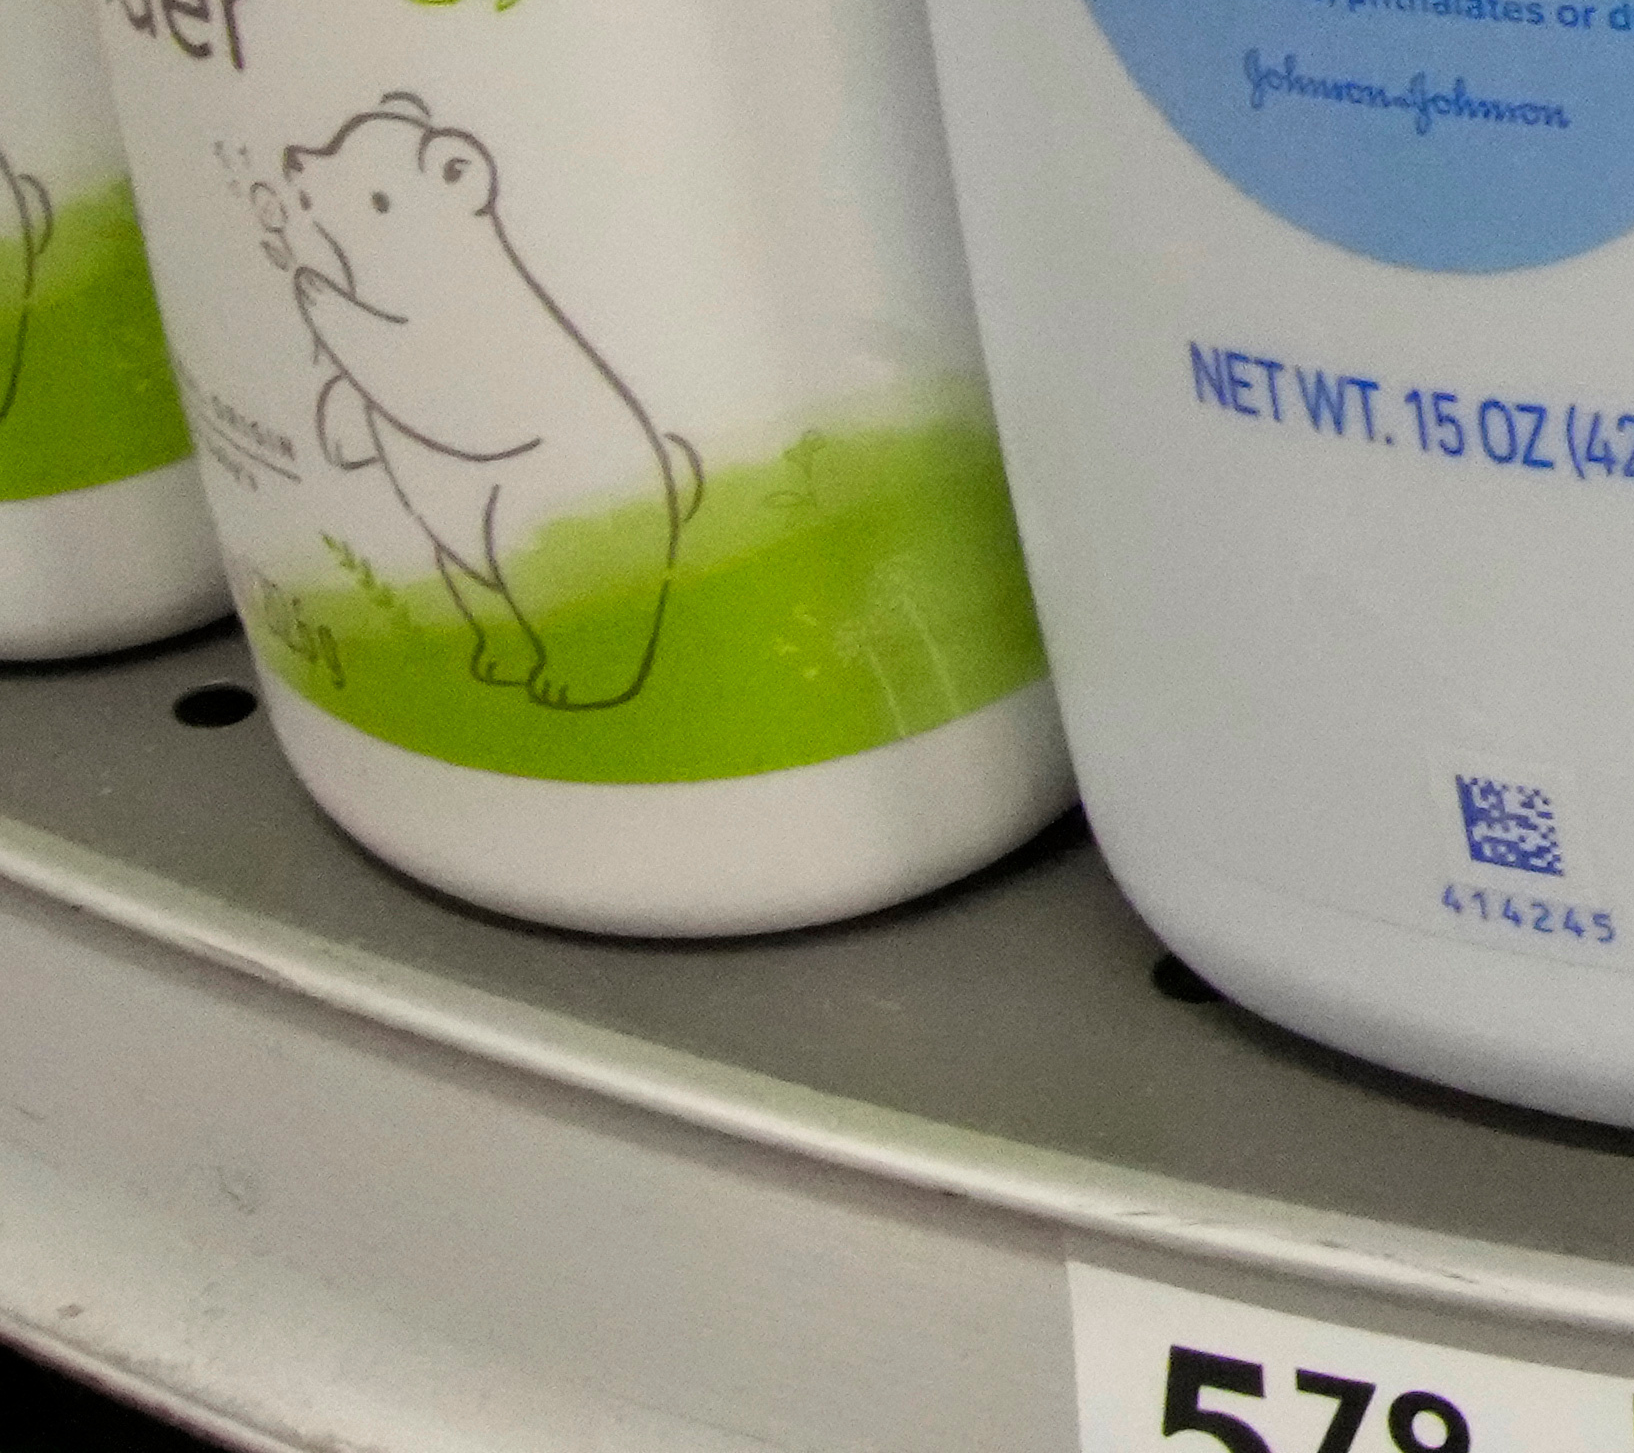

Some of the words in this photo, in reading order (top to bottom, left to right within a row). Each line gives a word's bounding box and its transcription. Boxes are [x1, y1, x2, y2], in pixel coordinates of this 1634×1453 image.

[1190, 341, 1284, 423] NET
[1296, 364, 1394, 447] WT.
[1404, 387, 1466, 458] 15
[1477, 398, 1555, 469] OZ
[1441, 883, 1617, 943] 414245
